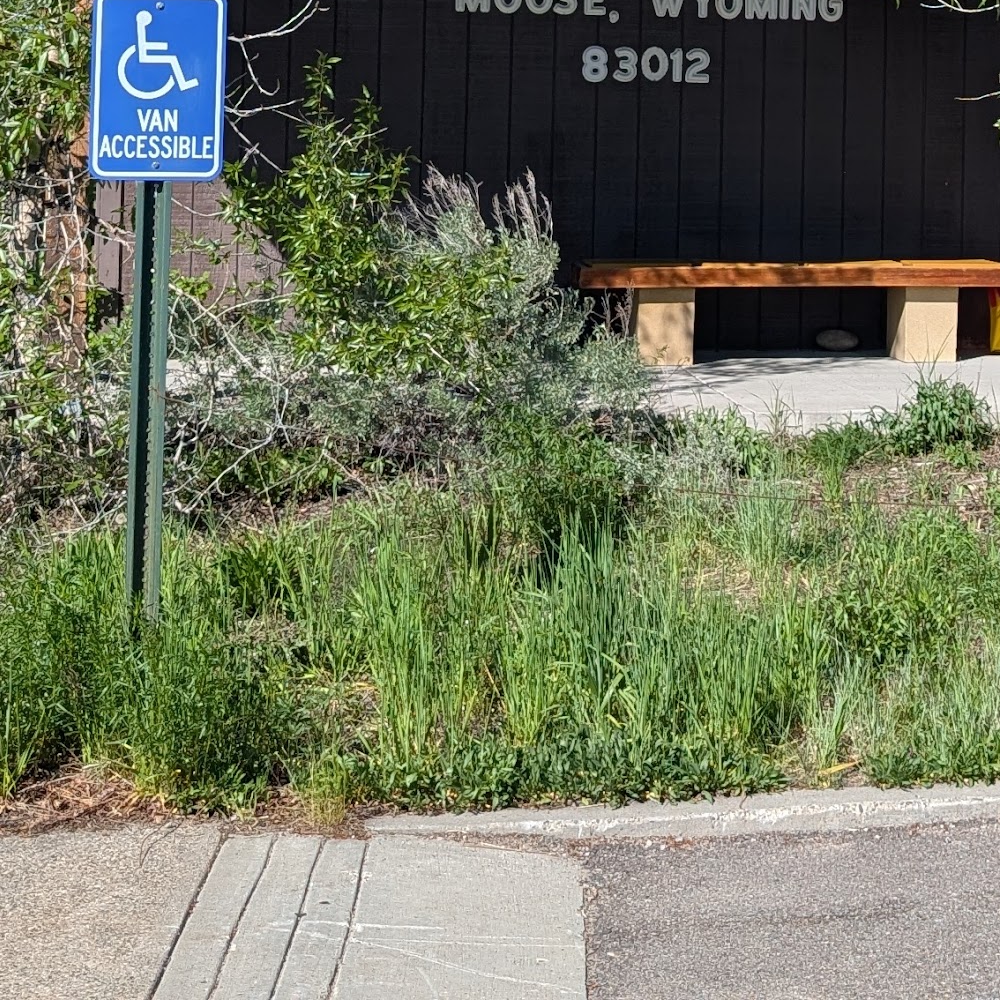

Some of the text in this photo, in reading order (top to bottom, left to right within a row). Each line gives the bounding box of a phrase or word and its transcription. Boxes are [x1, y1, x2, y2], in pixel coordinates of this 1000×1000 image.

[581, 46, 710, 83] 83012
[137, 109, 178, 132] VAN
[99, 135, 213, 159] ACCESSIBLE
